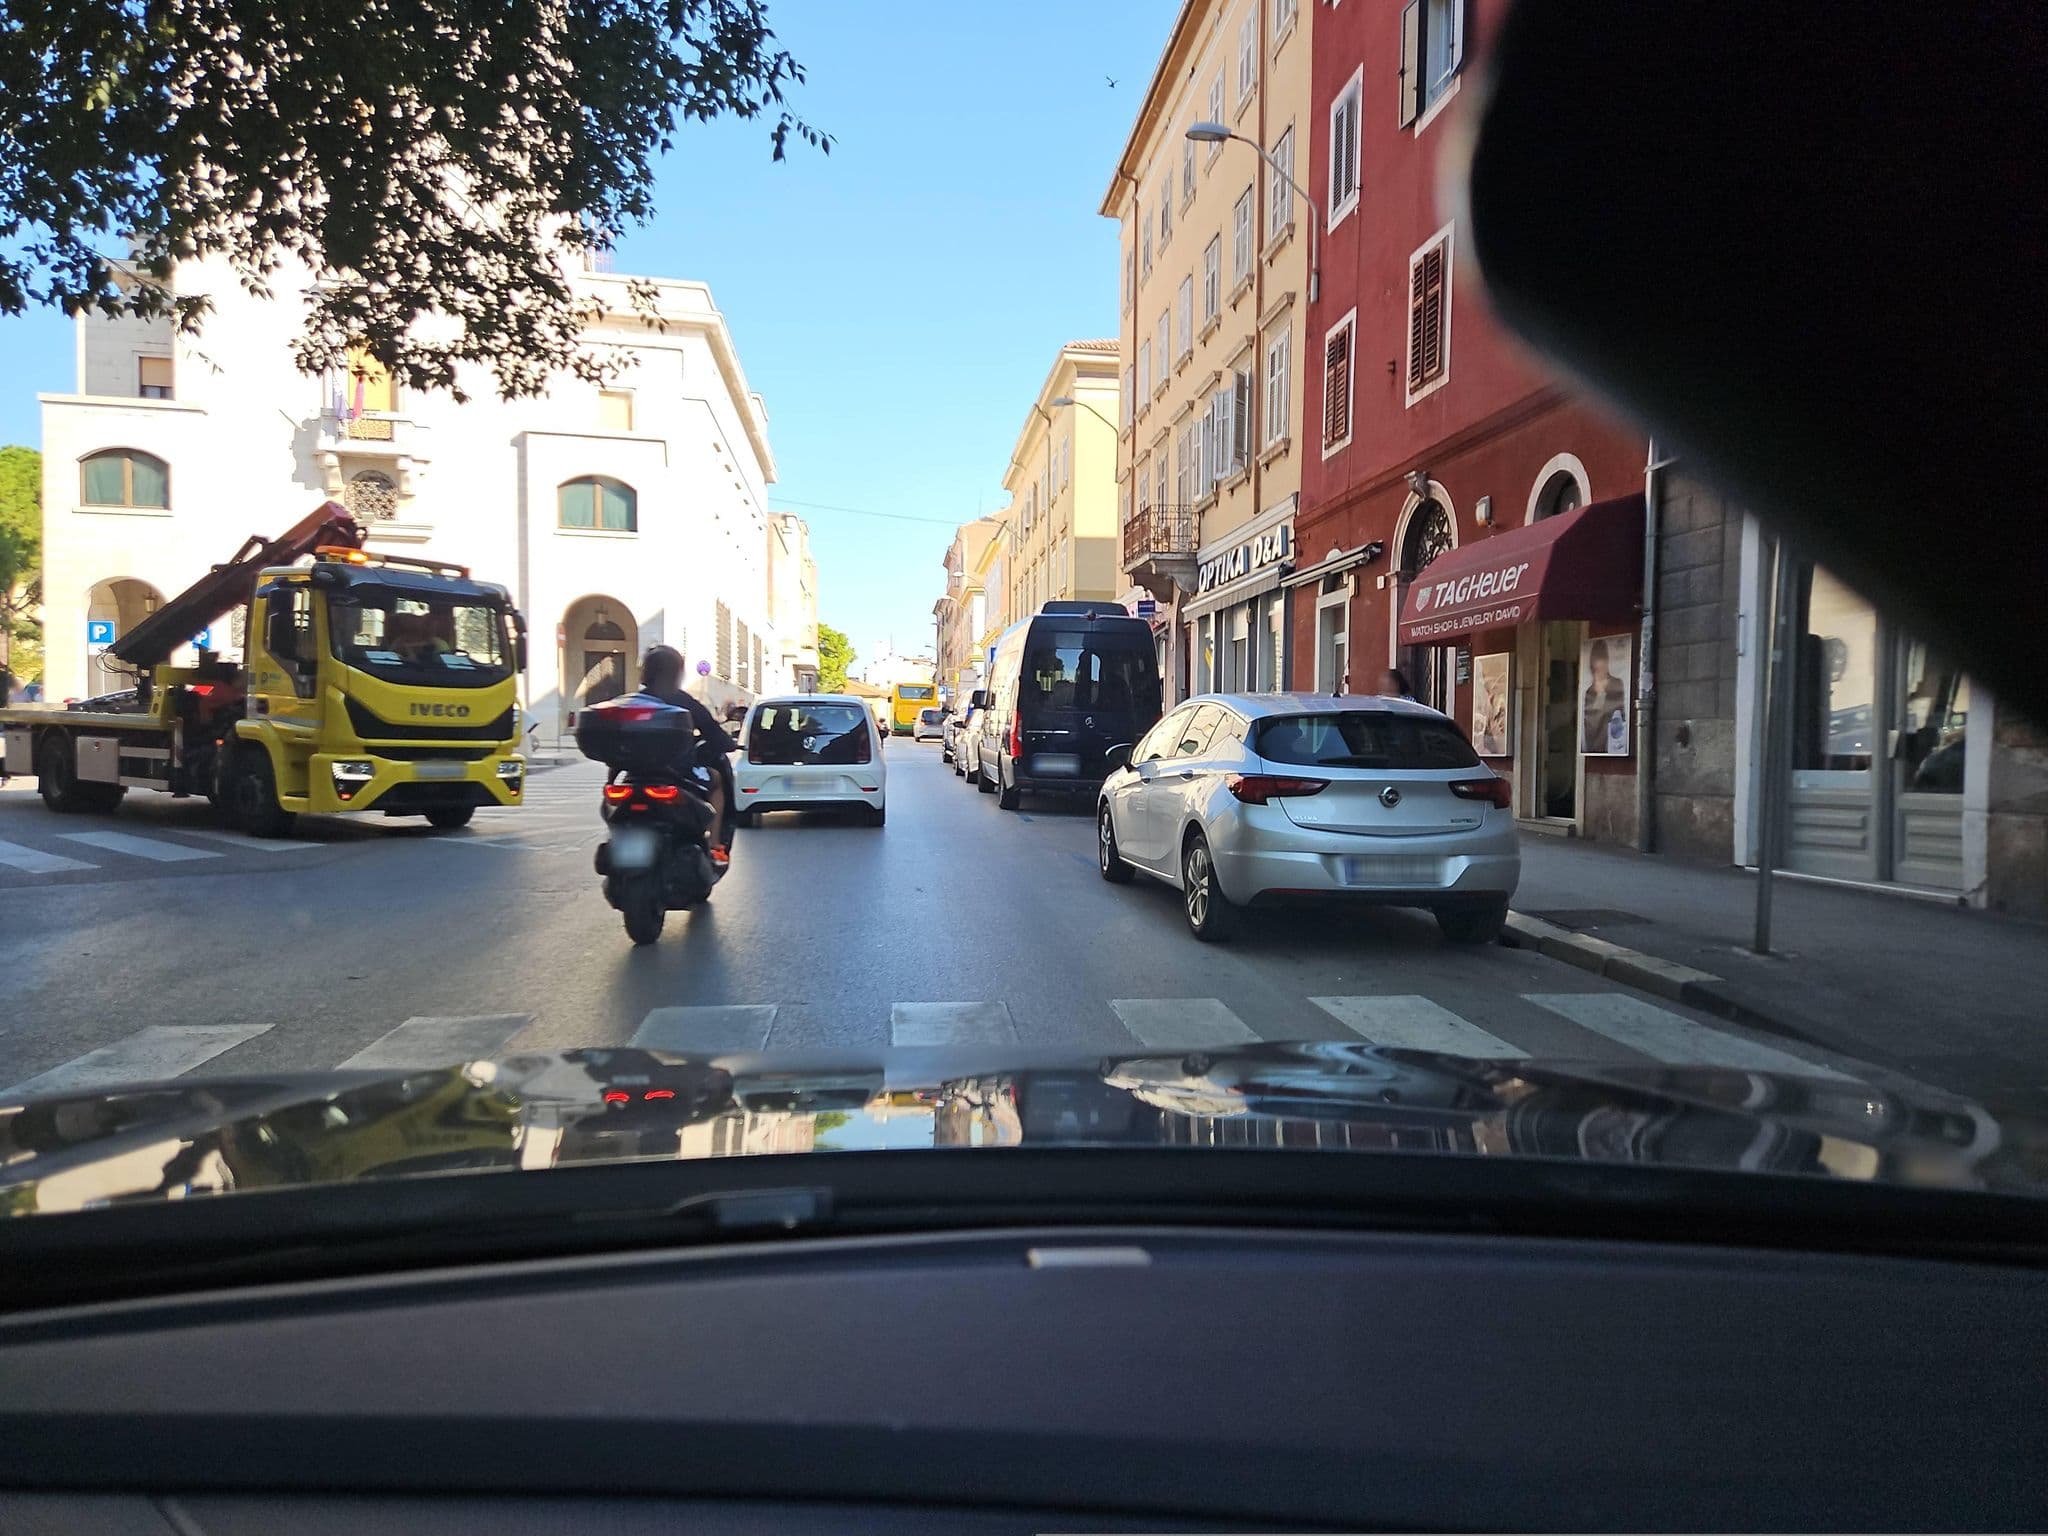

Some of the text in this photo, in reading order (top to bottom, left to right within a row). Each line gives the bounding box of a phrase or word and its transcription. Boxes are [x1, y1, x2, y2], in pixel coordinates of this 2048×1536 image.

[1199, 525, 1283, 593] OPTIKA D&A
[94, 624, 108, 641] P
[1411, 606, 1520, 637] WATCH SHOP & JEWELRY DAVID
[410, 703, 470, 717] IVECO
